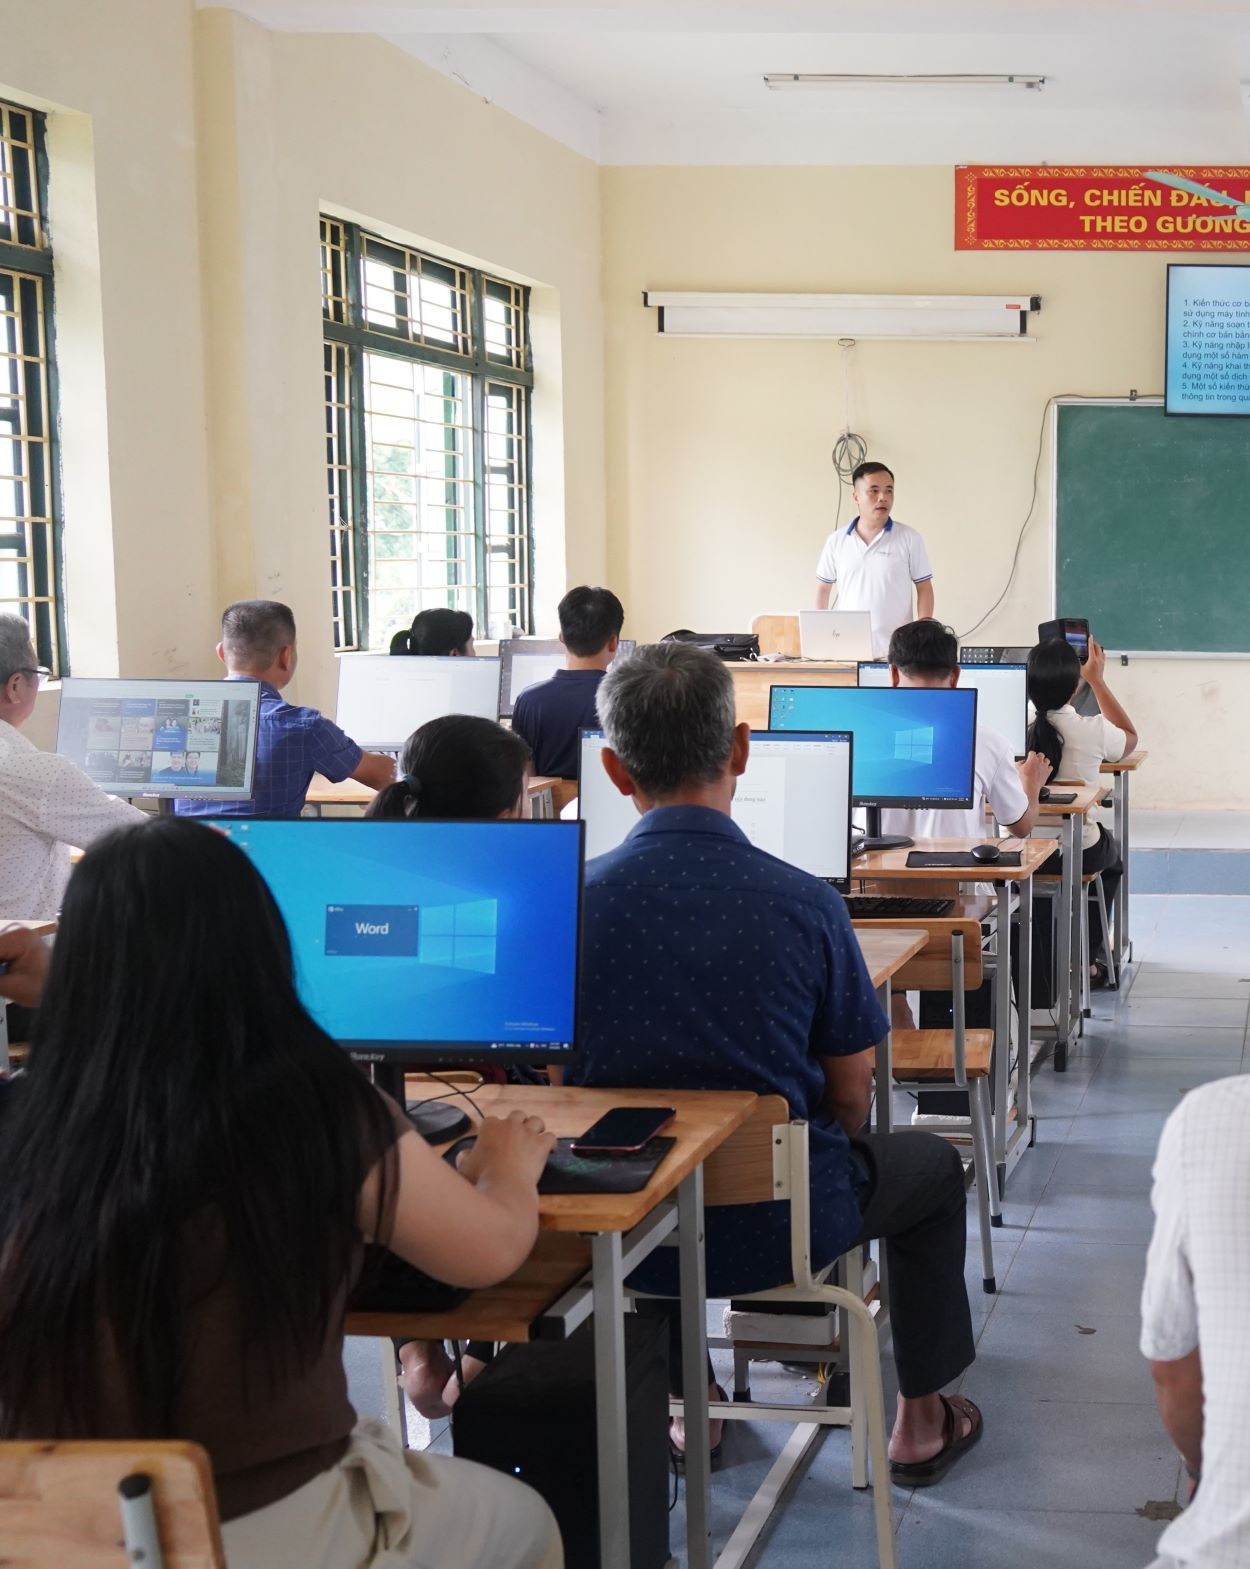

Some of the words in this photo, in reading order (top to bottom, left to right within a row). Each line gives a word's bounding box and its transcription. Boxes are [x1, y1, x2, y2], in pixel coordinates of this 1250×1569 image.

[994, 182, 1075, 208] SỐNG,
[1084, 182, 1162, 207] CHIẾN
[1080, 216, 1147, 232] THEO
[355, 922, 389, 935] Word
